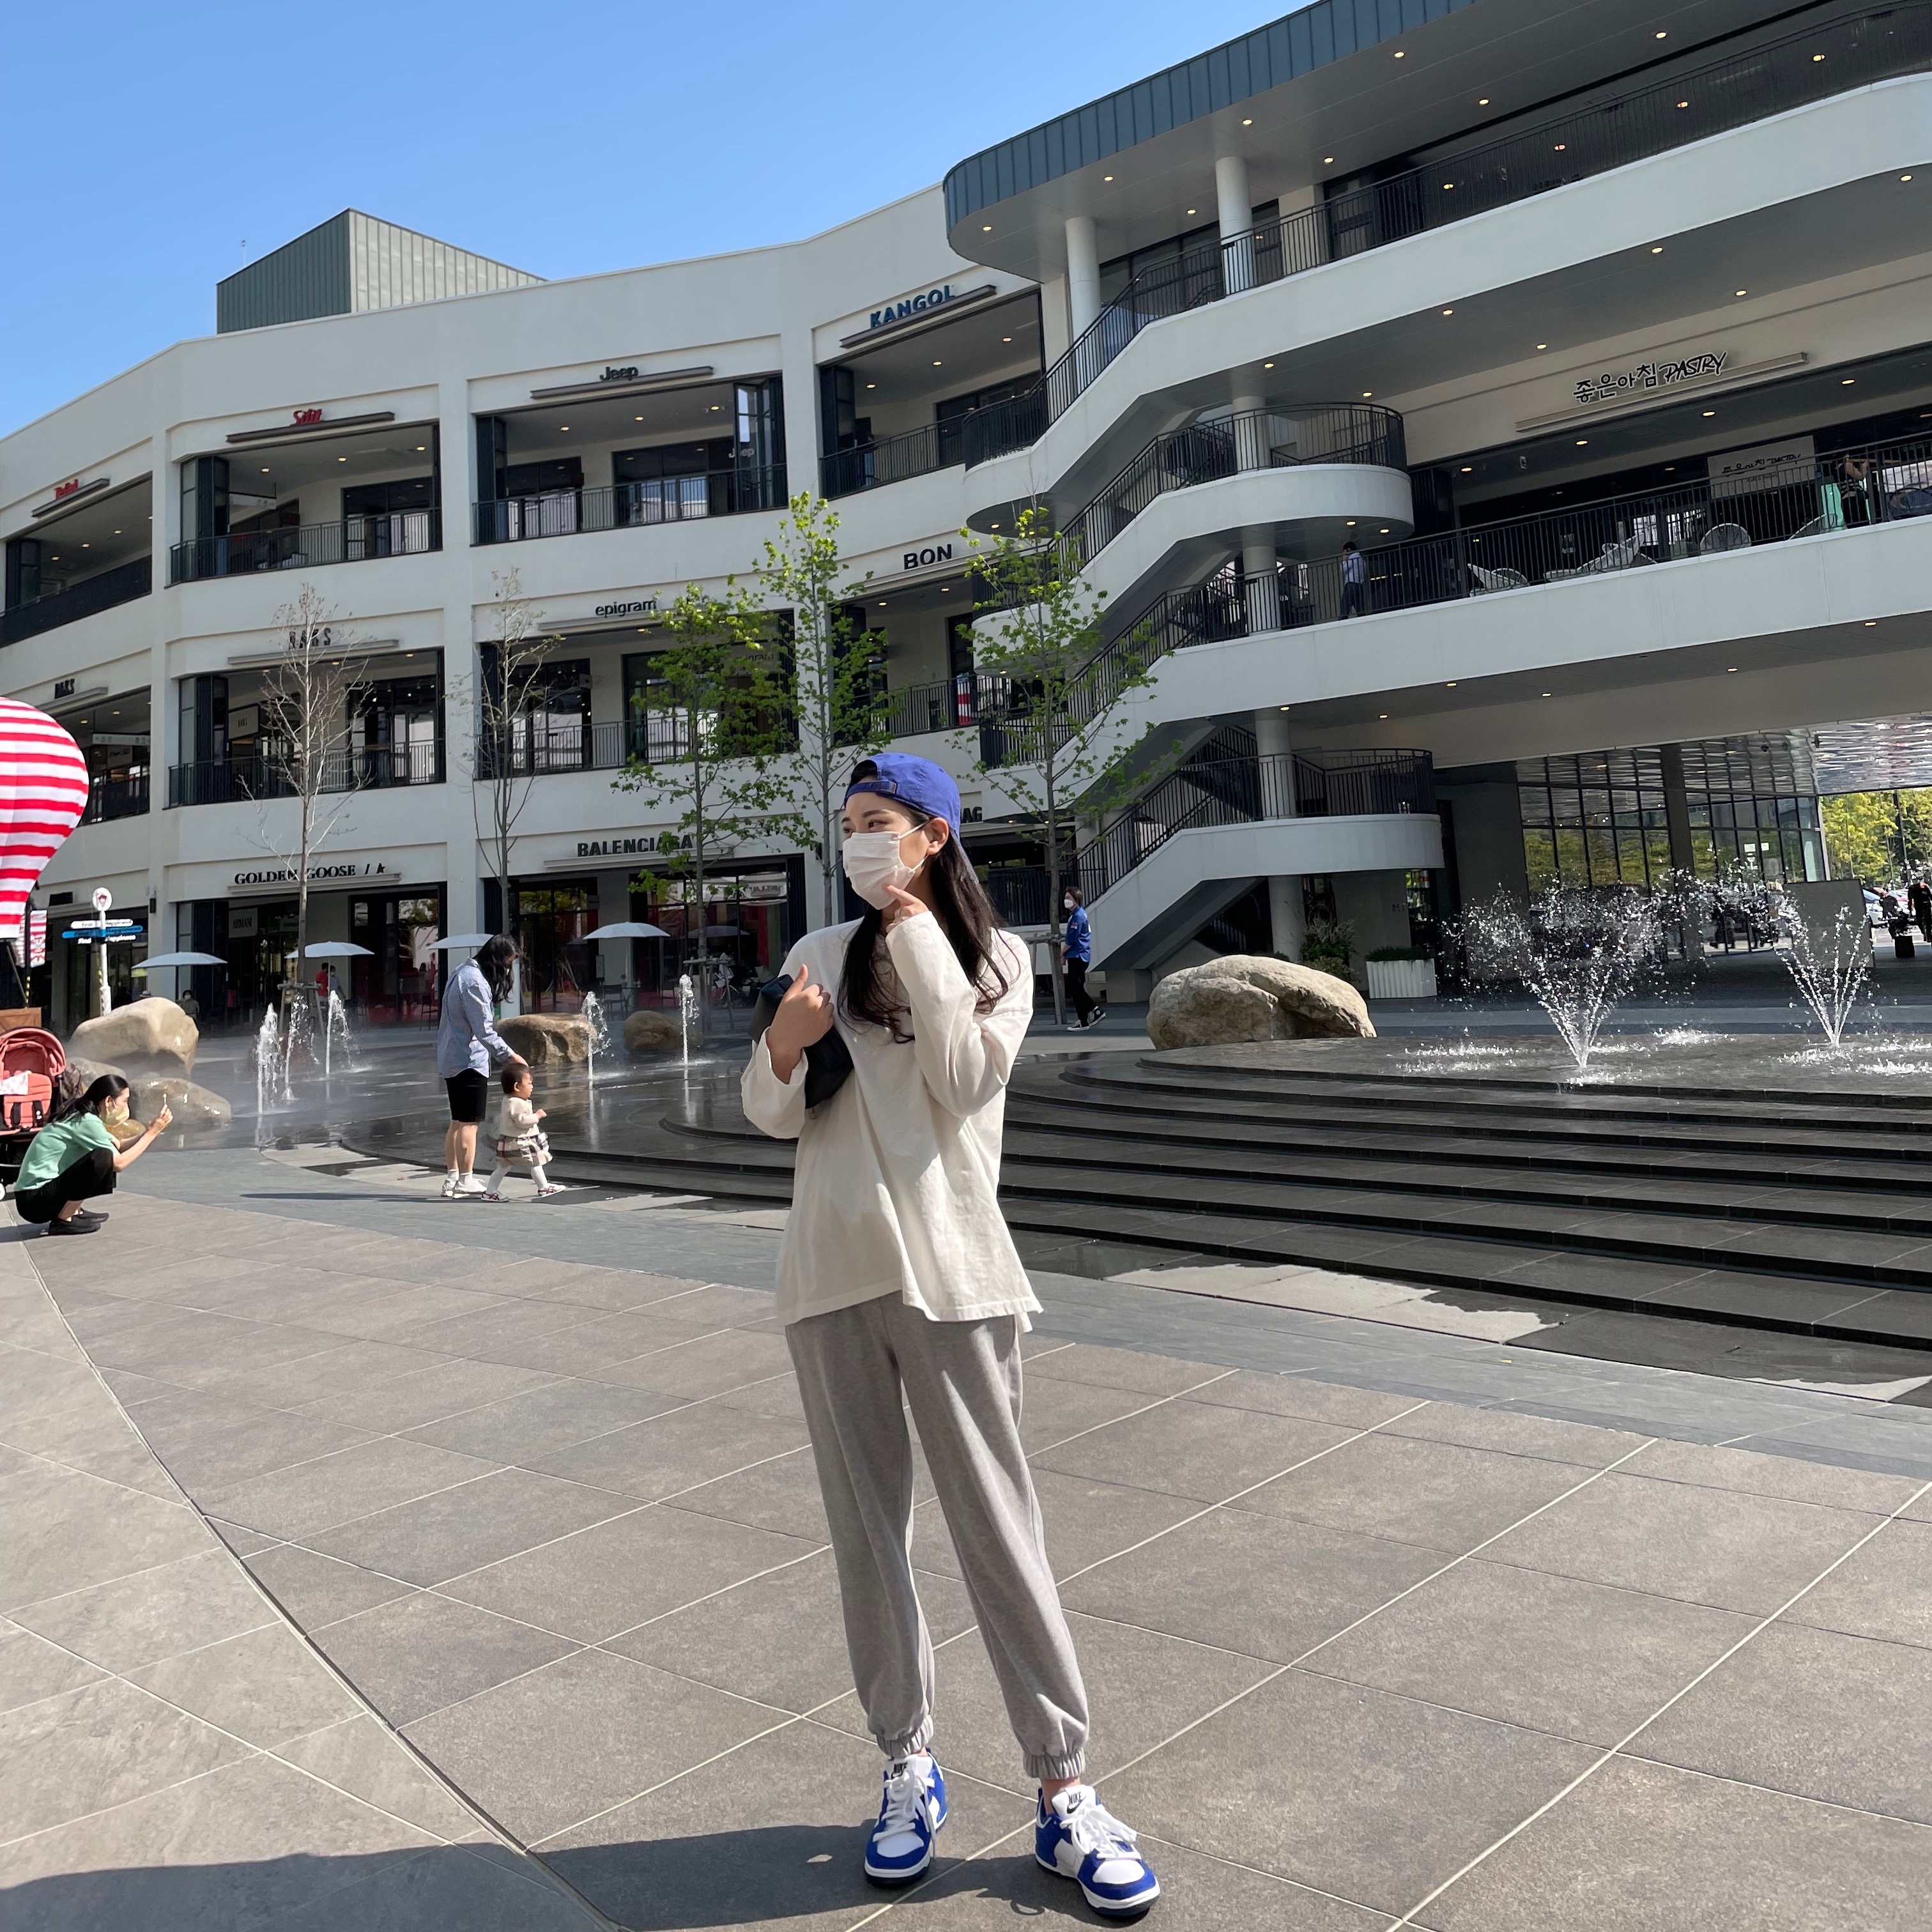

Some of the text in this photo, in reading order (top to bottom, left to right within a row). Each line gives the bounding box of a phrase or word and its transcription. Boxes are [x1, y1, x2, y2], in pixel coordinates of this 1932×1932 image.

[870, 285, 956, 328] KANGOL
[599, 366, 638, 381] Jeep
[1573, 351, 1727, 403] 좋은아침 PASTRY
[728, 448, 755, 458] Jep
[904, 544, 952, 570] BON
[595, 600, 657, 618] epigram
[960, 806, 983, 824] AG
[234, 869, 298, 884] GOLDEN
[305, 864, 356, 878] GOOSE
[1068, 1791, 1082, 1806] NIKE
